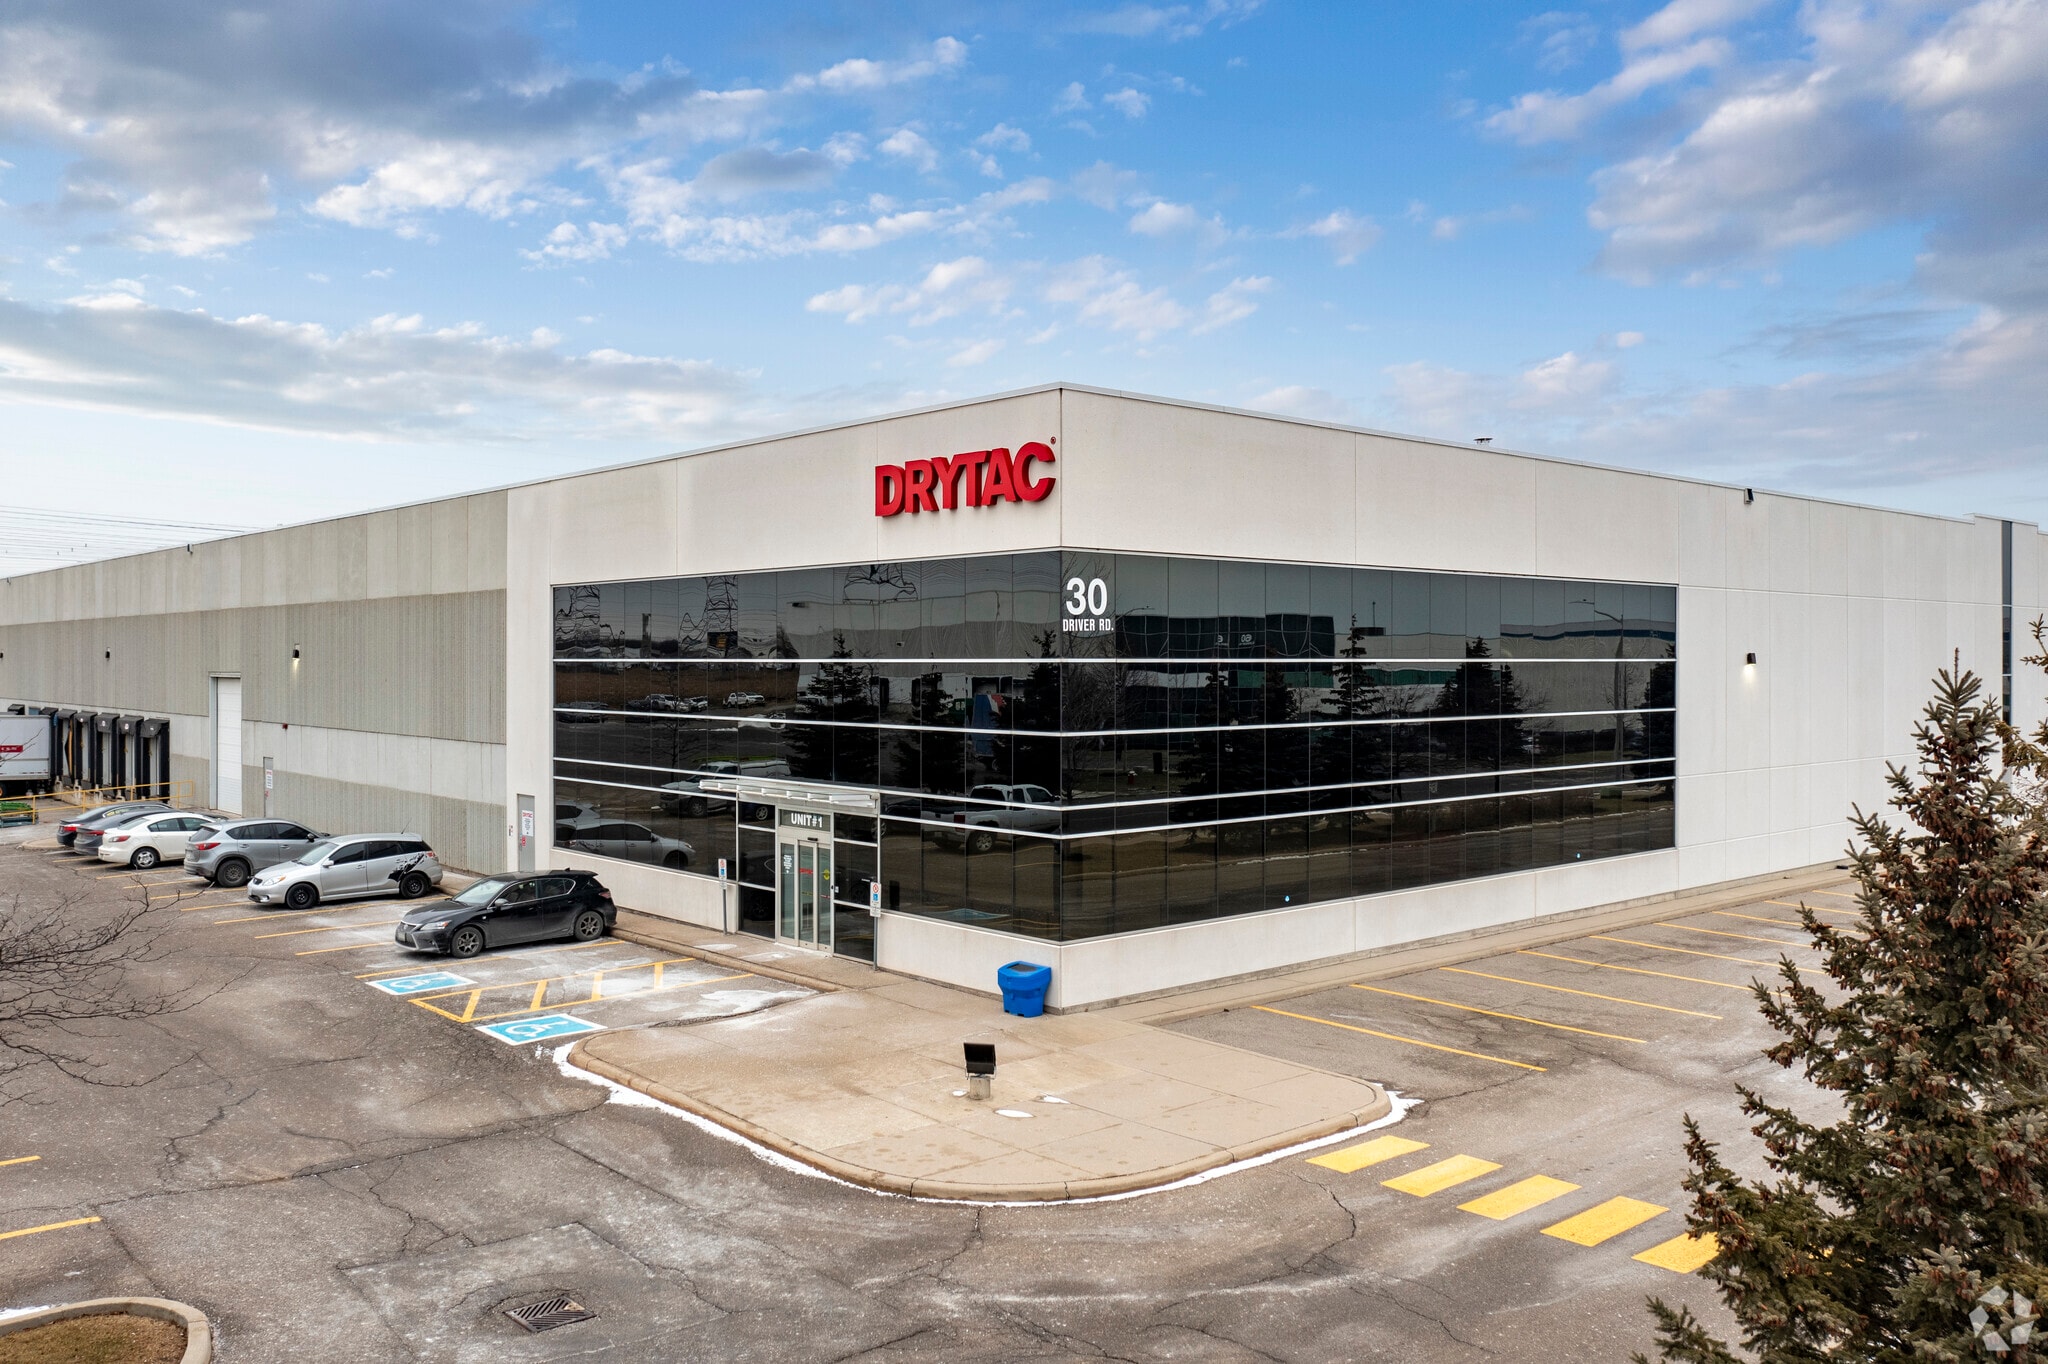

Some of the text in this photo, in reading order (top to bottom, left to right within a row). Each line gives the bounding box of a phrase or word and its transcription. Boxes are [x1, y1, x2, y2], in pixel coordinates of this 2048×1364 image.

[875, 441, 1056, 517] DRYTAC
[1066, 577, 1108, 616] 30
[1063, 618, 1114, 632] DRIVER RD.
